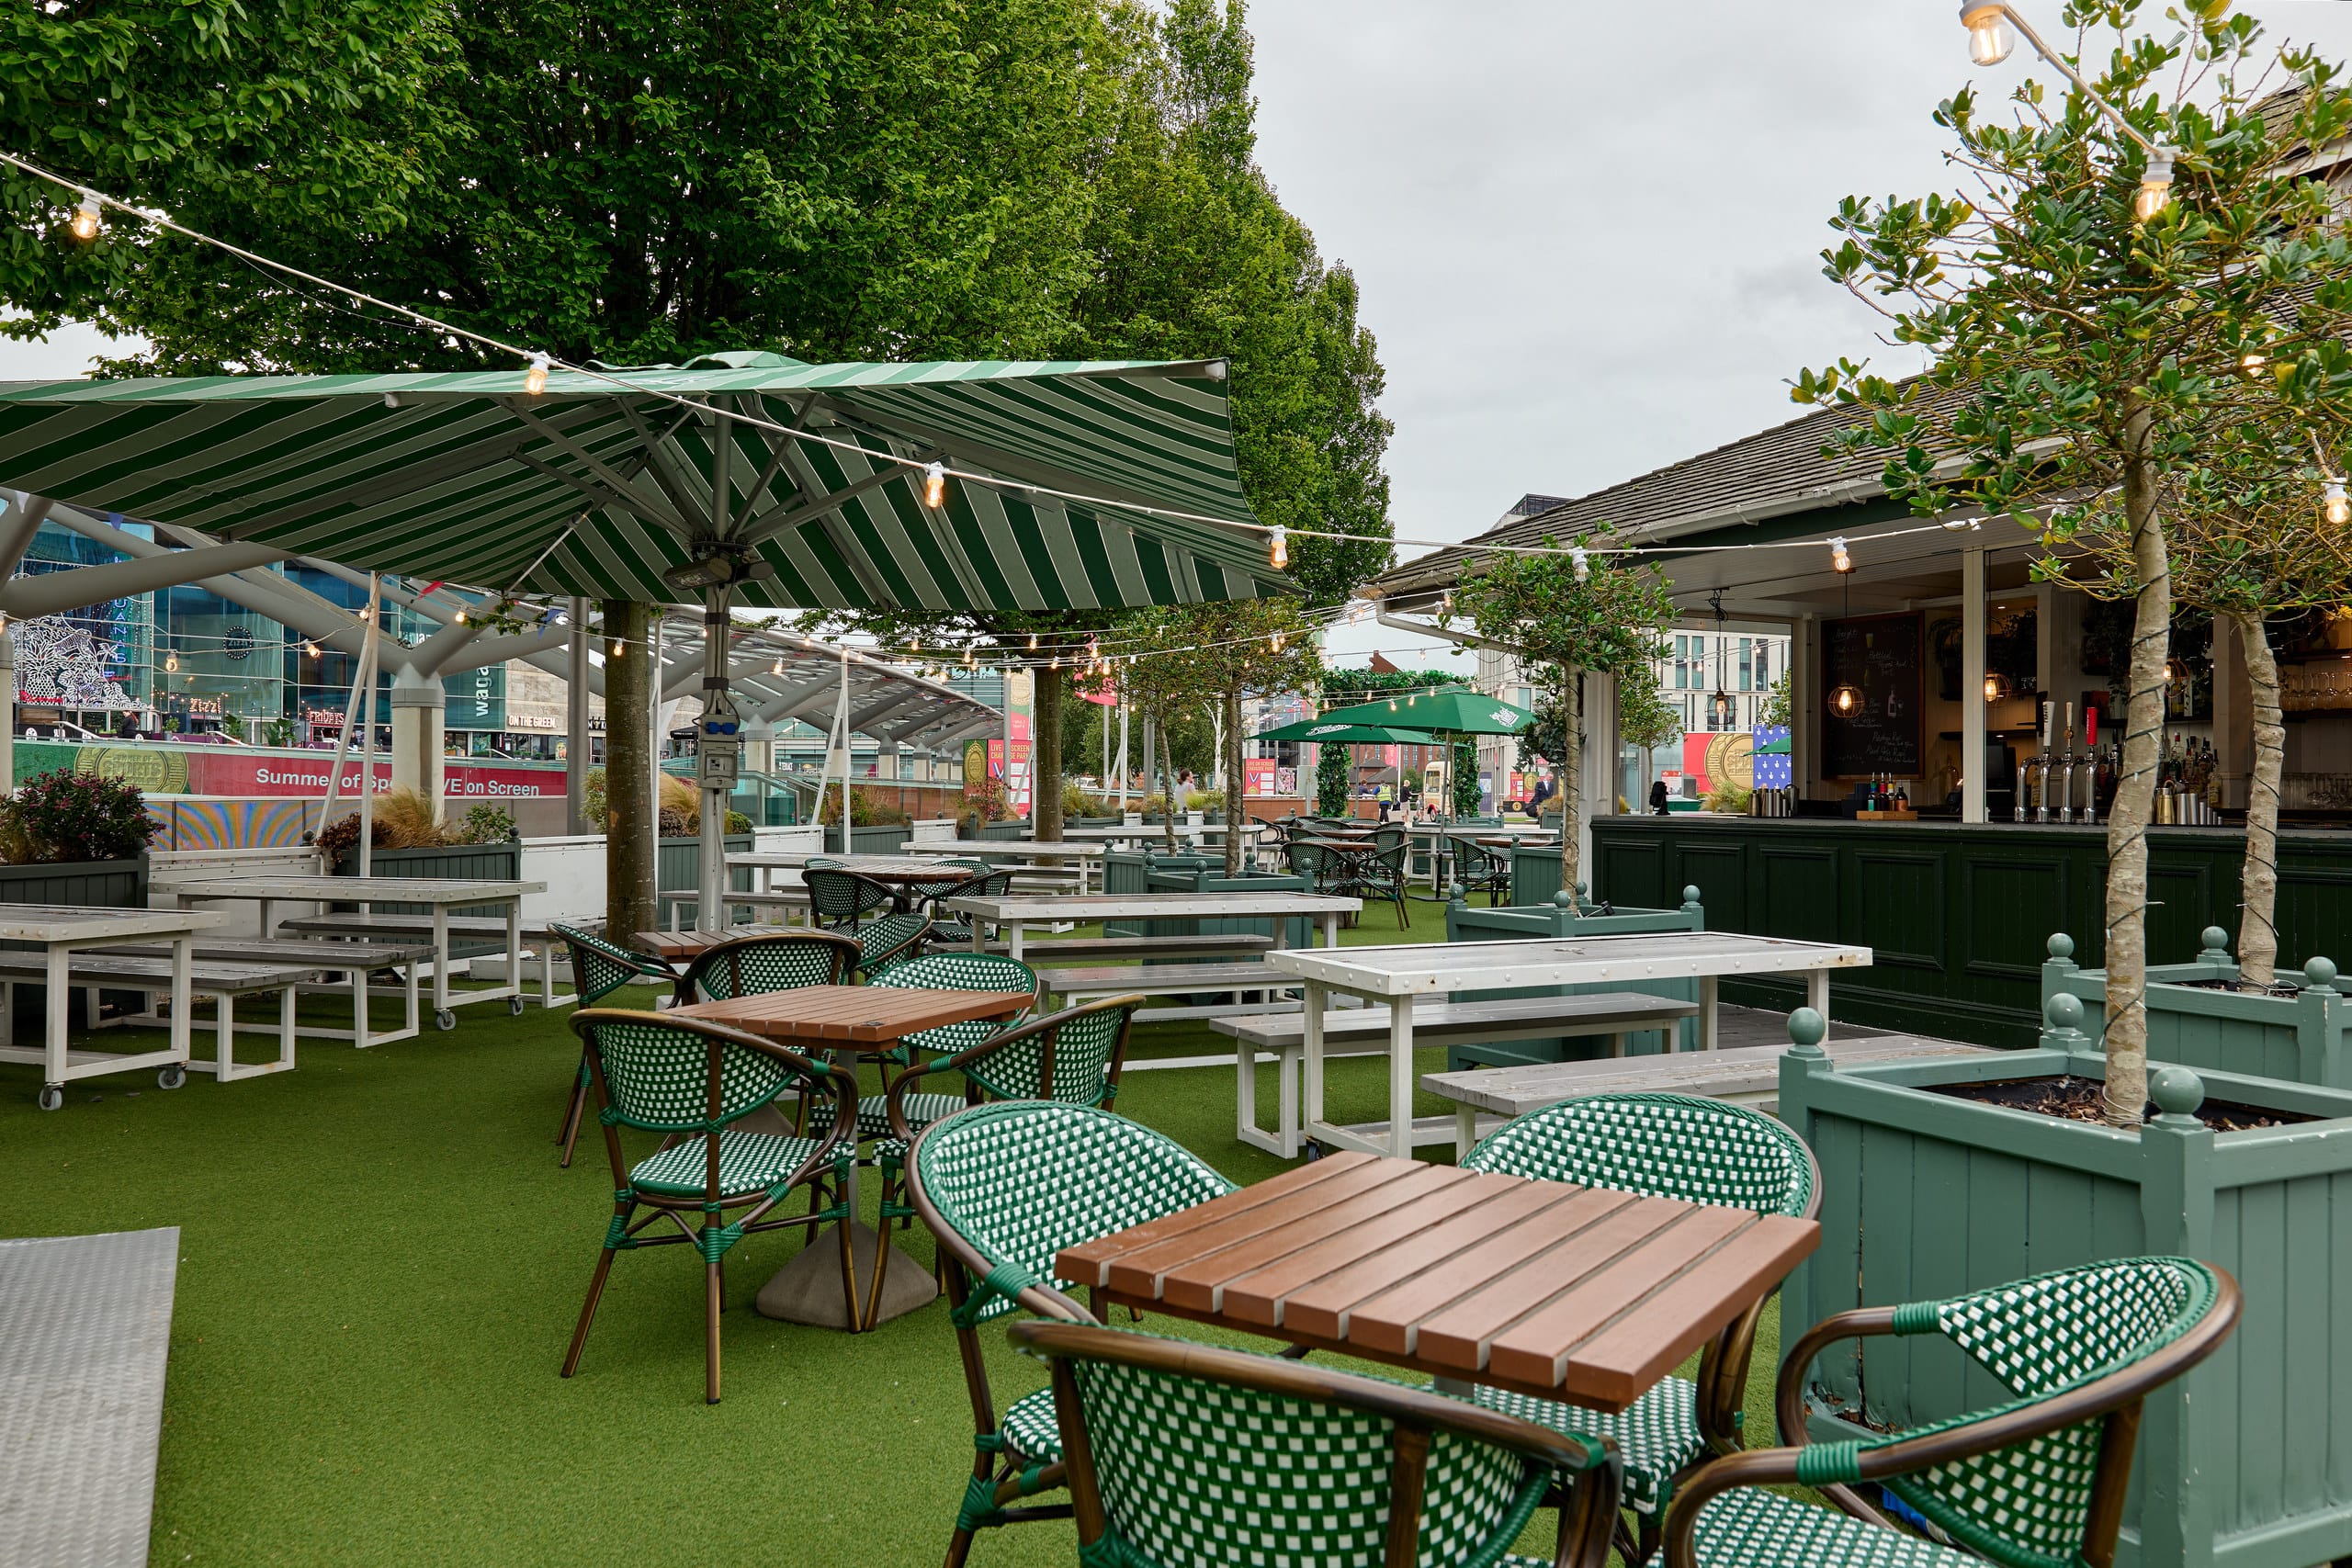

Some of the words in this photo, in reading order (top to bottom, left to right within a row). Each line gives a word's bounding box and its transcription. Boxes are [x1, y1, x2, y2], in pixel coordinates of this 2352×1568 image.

[475, 665, 493, 716] waga
[508, 715, 519, 726] ON
[520, 716, 533, 727] THE
[990, 743, 1002, 751] LIVE
[1011, 744, 1030, 752] SCREEN
[102, 761, 163, 777] SPORTS
[255, 768, 329, 786] Summe
[341, 773, 361, 788] of
[466, 782, 484, 794] on
[488, 780, 539, 796] Screen
